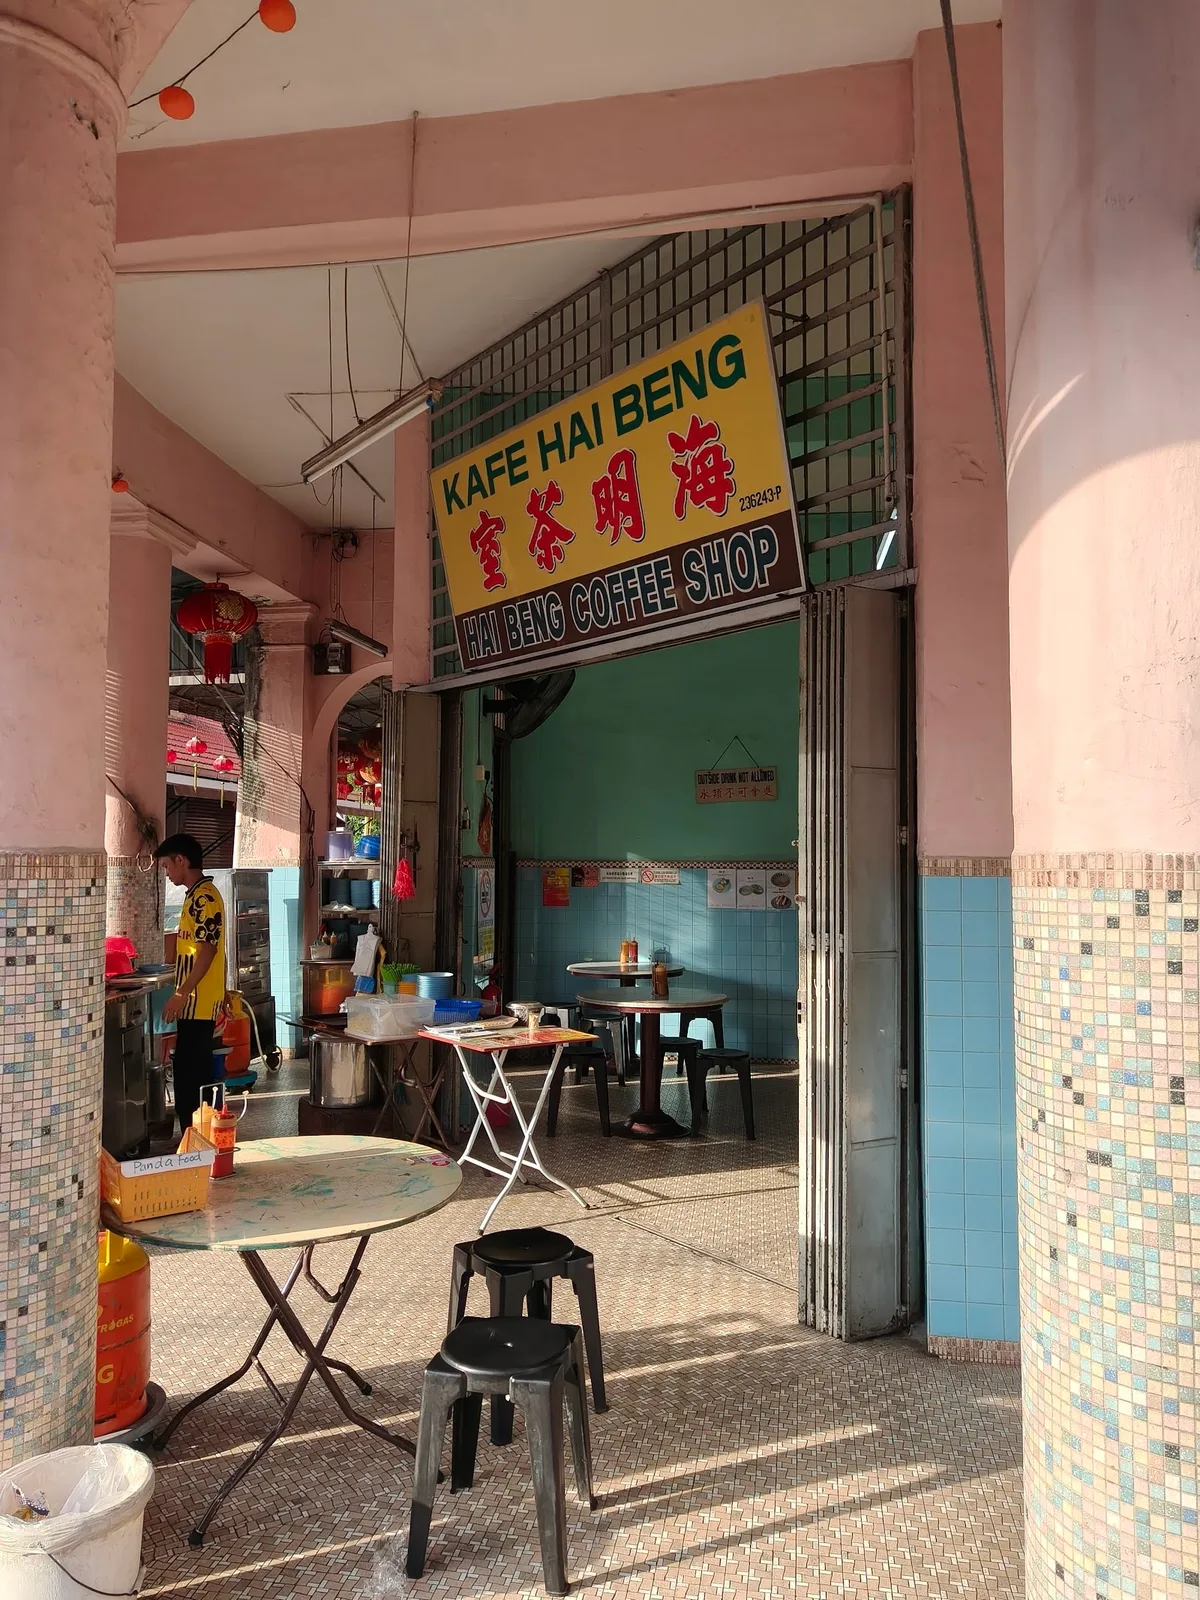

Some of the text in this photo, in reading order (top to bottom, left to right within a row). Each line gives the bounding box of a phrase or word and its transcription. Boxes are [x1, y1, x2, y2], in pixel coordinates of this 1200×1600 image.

[442, 333, 747, 516] KAFE HAI BENG
[739, 485, 782, 512] 236243-P
[462, 524, 780, 661] HAI BENG COFFEE SHOP
[697, 770, 775, 785] OUTSIDE DRINK NOT ALLOWED
[133, 1151, 202, 1174] Panda Food
